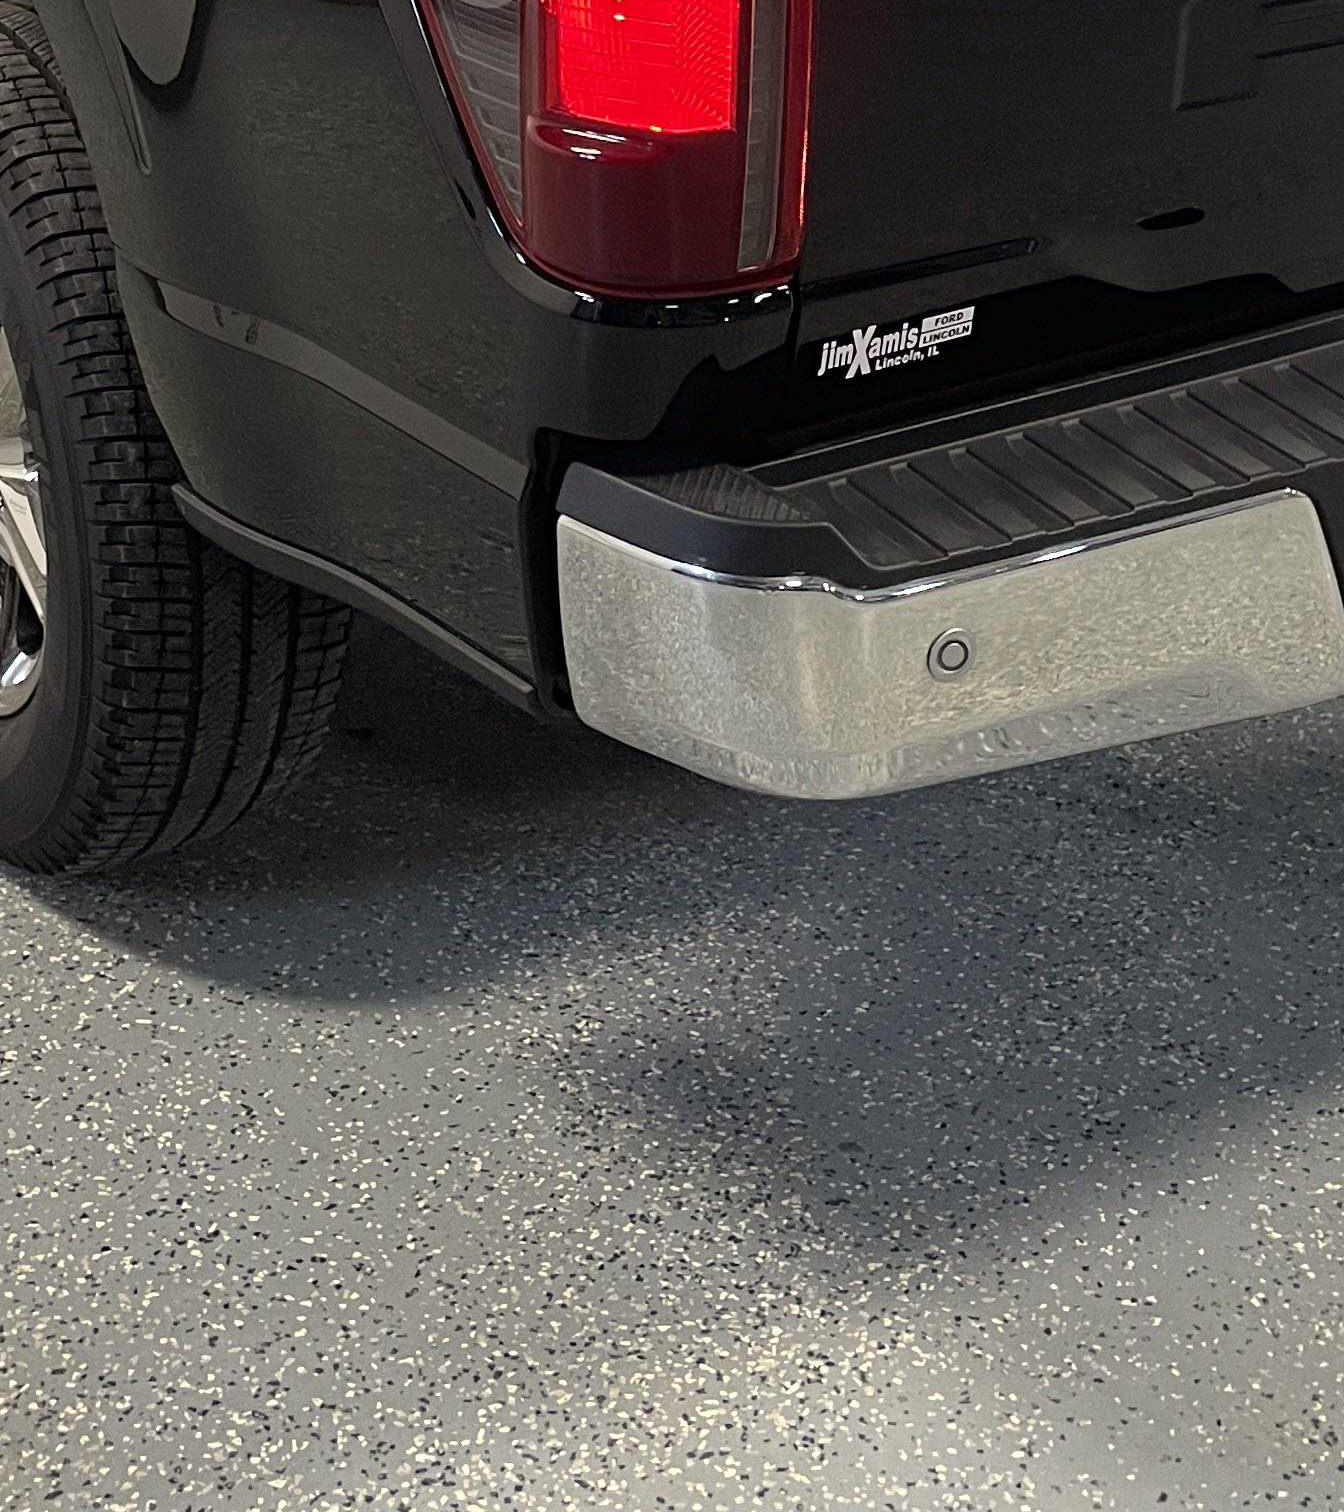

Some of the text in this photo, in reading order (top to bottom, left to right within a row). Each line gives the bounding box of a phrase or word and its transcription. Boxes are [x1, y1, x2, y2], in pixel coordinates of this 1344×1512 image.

[934, 311, 964, 328] FORD
[922, 324, 971, 345] LINCOLN
[875, 345, 939, 371] Lincoln, IL
